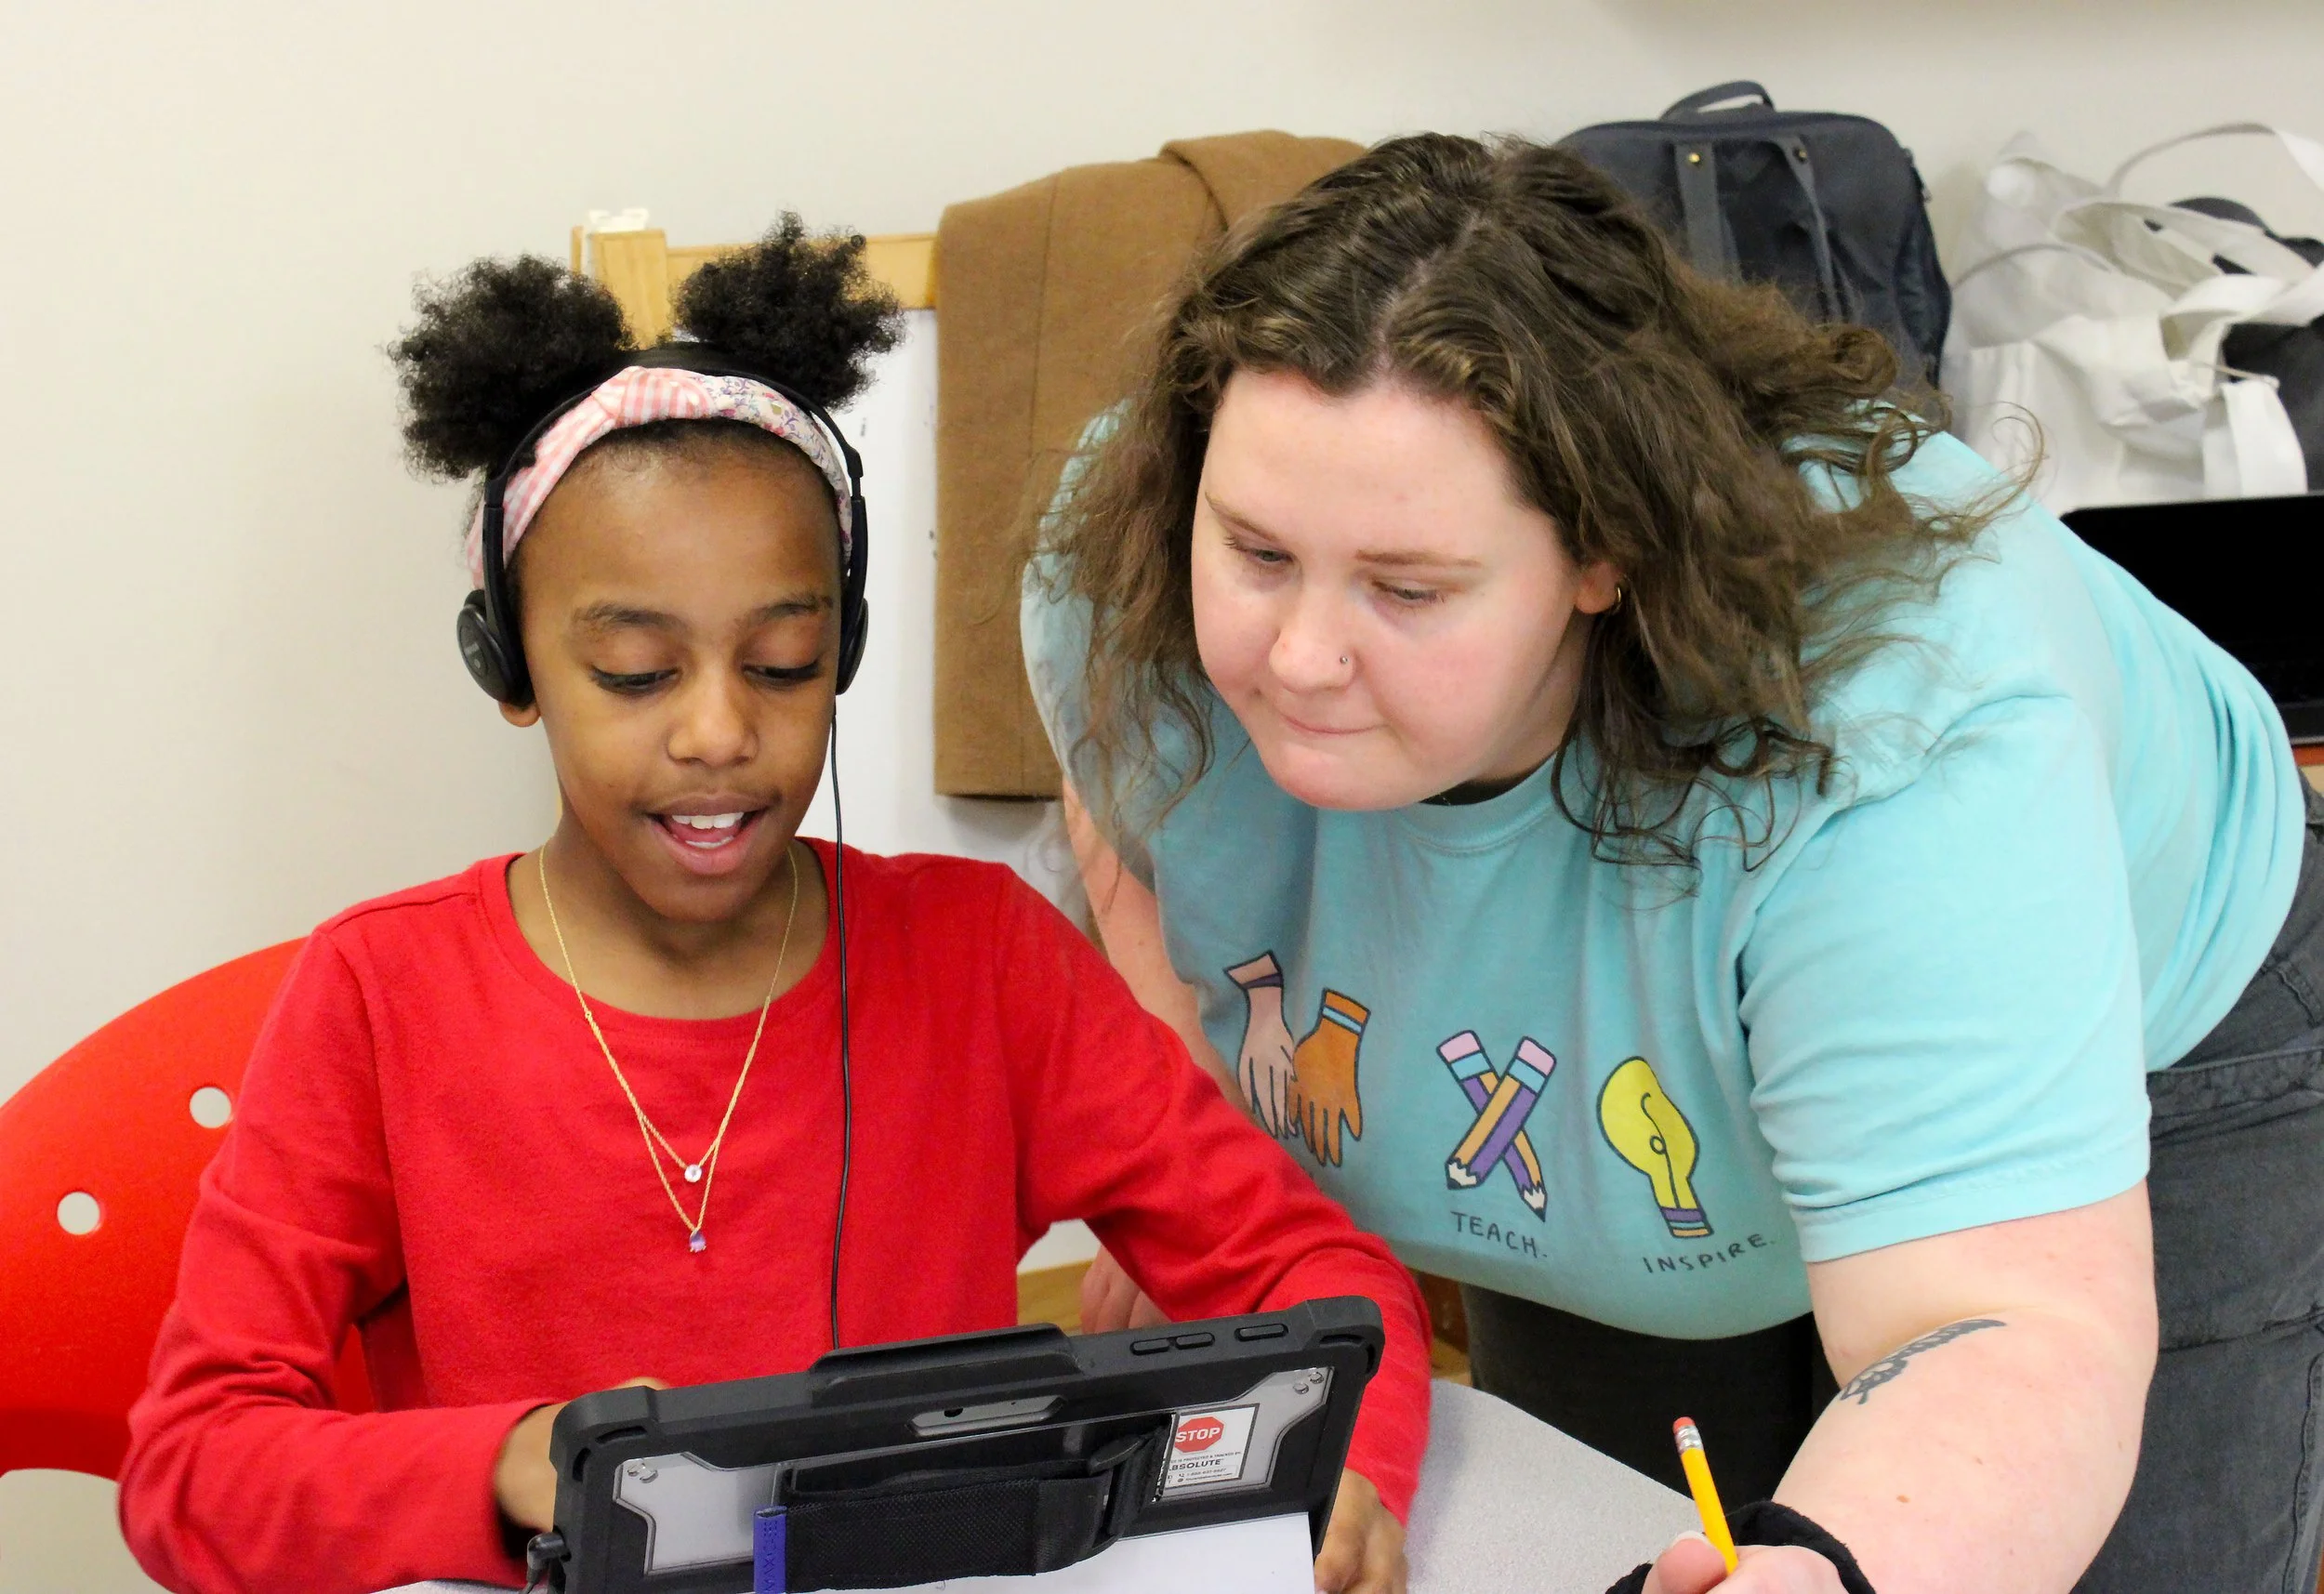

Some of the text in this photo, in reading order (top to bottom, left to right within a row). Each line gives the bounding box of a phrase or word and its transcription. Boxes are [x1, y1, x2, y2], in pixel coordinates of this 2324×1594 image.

[1450, 1210, 1548, 1258] TEACH.
[1643, 1233, 1776, 1273] INSPIRE.
[1175, 1427, 1221, 1443] STOP
